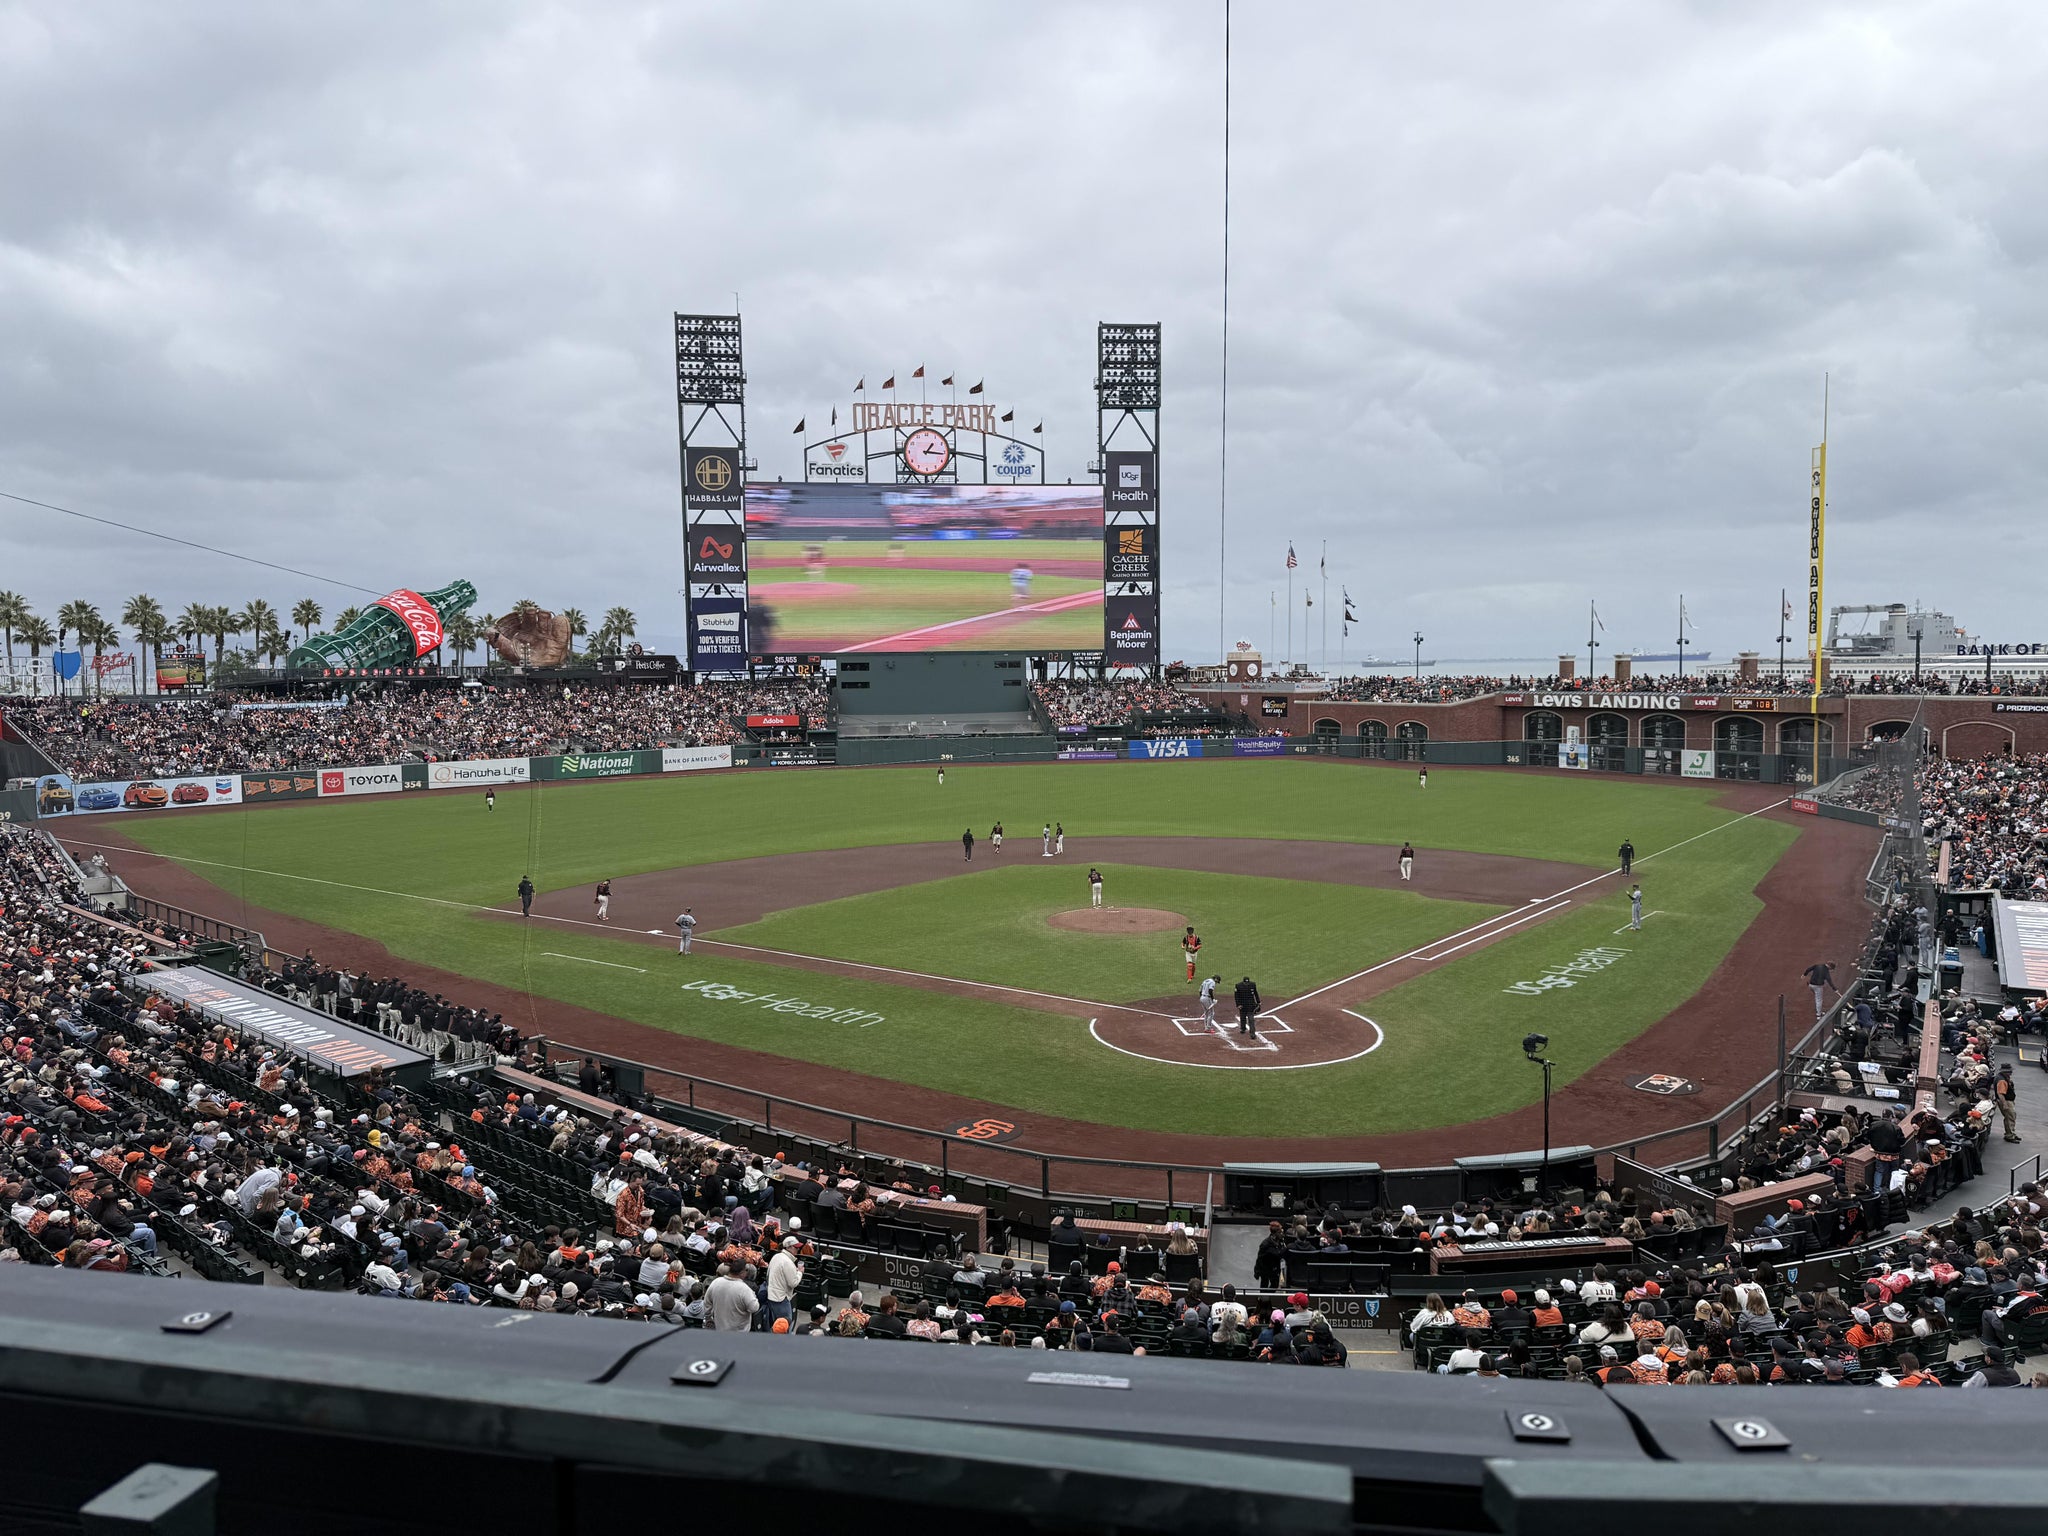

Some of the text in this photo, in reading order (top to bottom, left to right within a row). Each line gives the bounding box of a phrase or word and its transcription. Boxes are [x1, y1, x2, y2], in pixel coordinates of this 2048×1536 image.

[853, 403, 998, 434] ORACLE PARK
[809, 463, 864, 477] Fanatics
[997, 464, 1033, 478] coupa
[1121, 472, 1139, 481] UCSF
[690, 494, 721, 502] HABBAS
[1112, 490, 1148, 501] Health
[1811, 498, 1820, 559] CHIKIN
[1112, 555, 1149, 563] CACHE
[693, 562, 740, 572] Airwallex
[1810, 566, 1818, 587] IZ
[1809, 592, 1818, 634] FARE
[702, 618, 734, 626] StubHub
[699, 635, 739, 644] 100% VERIFIED
[1110, 630, 1152, 640] Benjamin
[697, 645, 741, 653] GIANTS TICKETS
[1116, 640, 1146, 648] Moore
[1957, 643, 2041, 656] BANK OF
[636, 661, 665, 670] Peet's Coffee
[1588, 696, 1681, 710] LANDING
[1143, 741, 1189, 757] VISA
[1237, 741, 1281, 749] HealthEquity
[579, 755, 634, 769] National
[454, 766, 525, 779] Hanwha Life
[1795, 773, 1812, 782] 309
[349, 775, 398, 786] TOYOTA
[404, 781, 422, 789] 354
[1794, 802, 1814, 810] ORACLE
[682, 980, 885, 1027] UCSF Health
[229, 1007, 336, 1045] FRANCISCO
[307, 1039, 397, 1070] GIANTS
[1464, 1235, 1599, 1250] Audi Dugout Club
[885, 1257, 919, 1277] blue
[890, 1278, 911, 1288] FIELD
[1318, 1297, 1360, 1315] blue
[1351, 1319, 1373, 1328] CLUB
